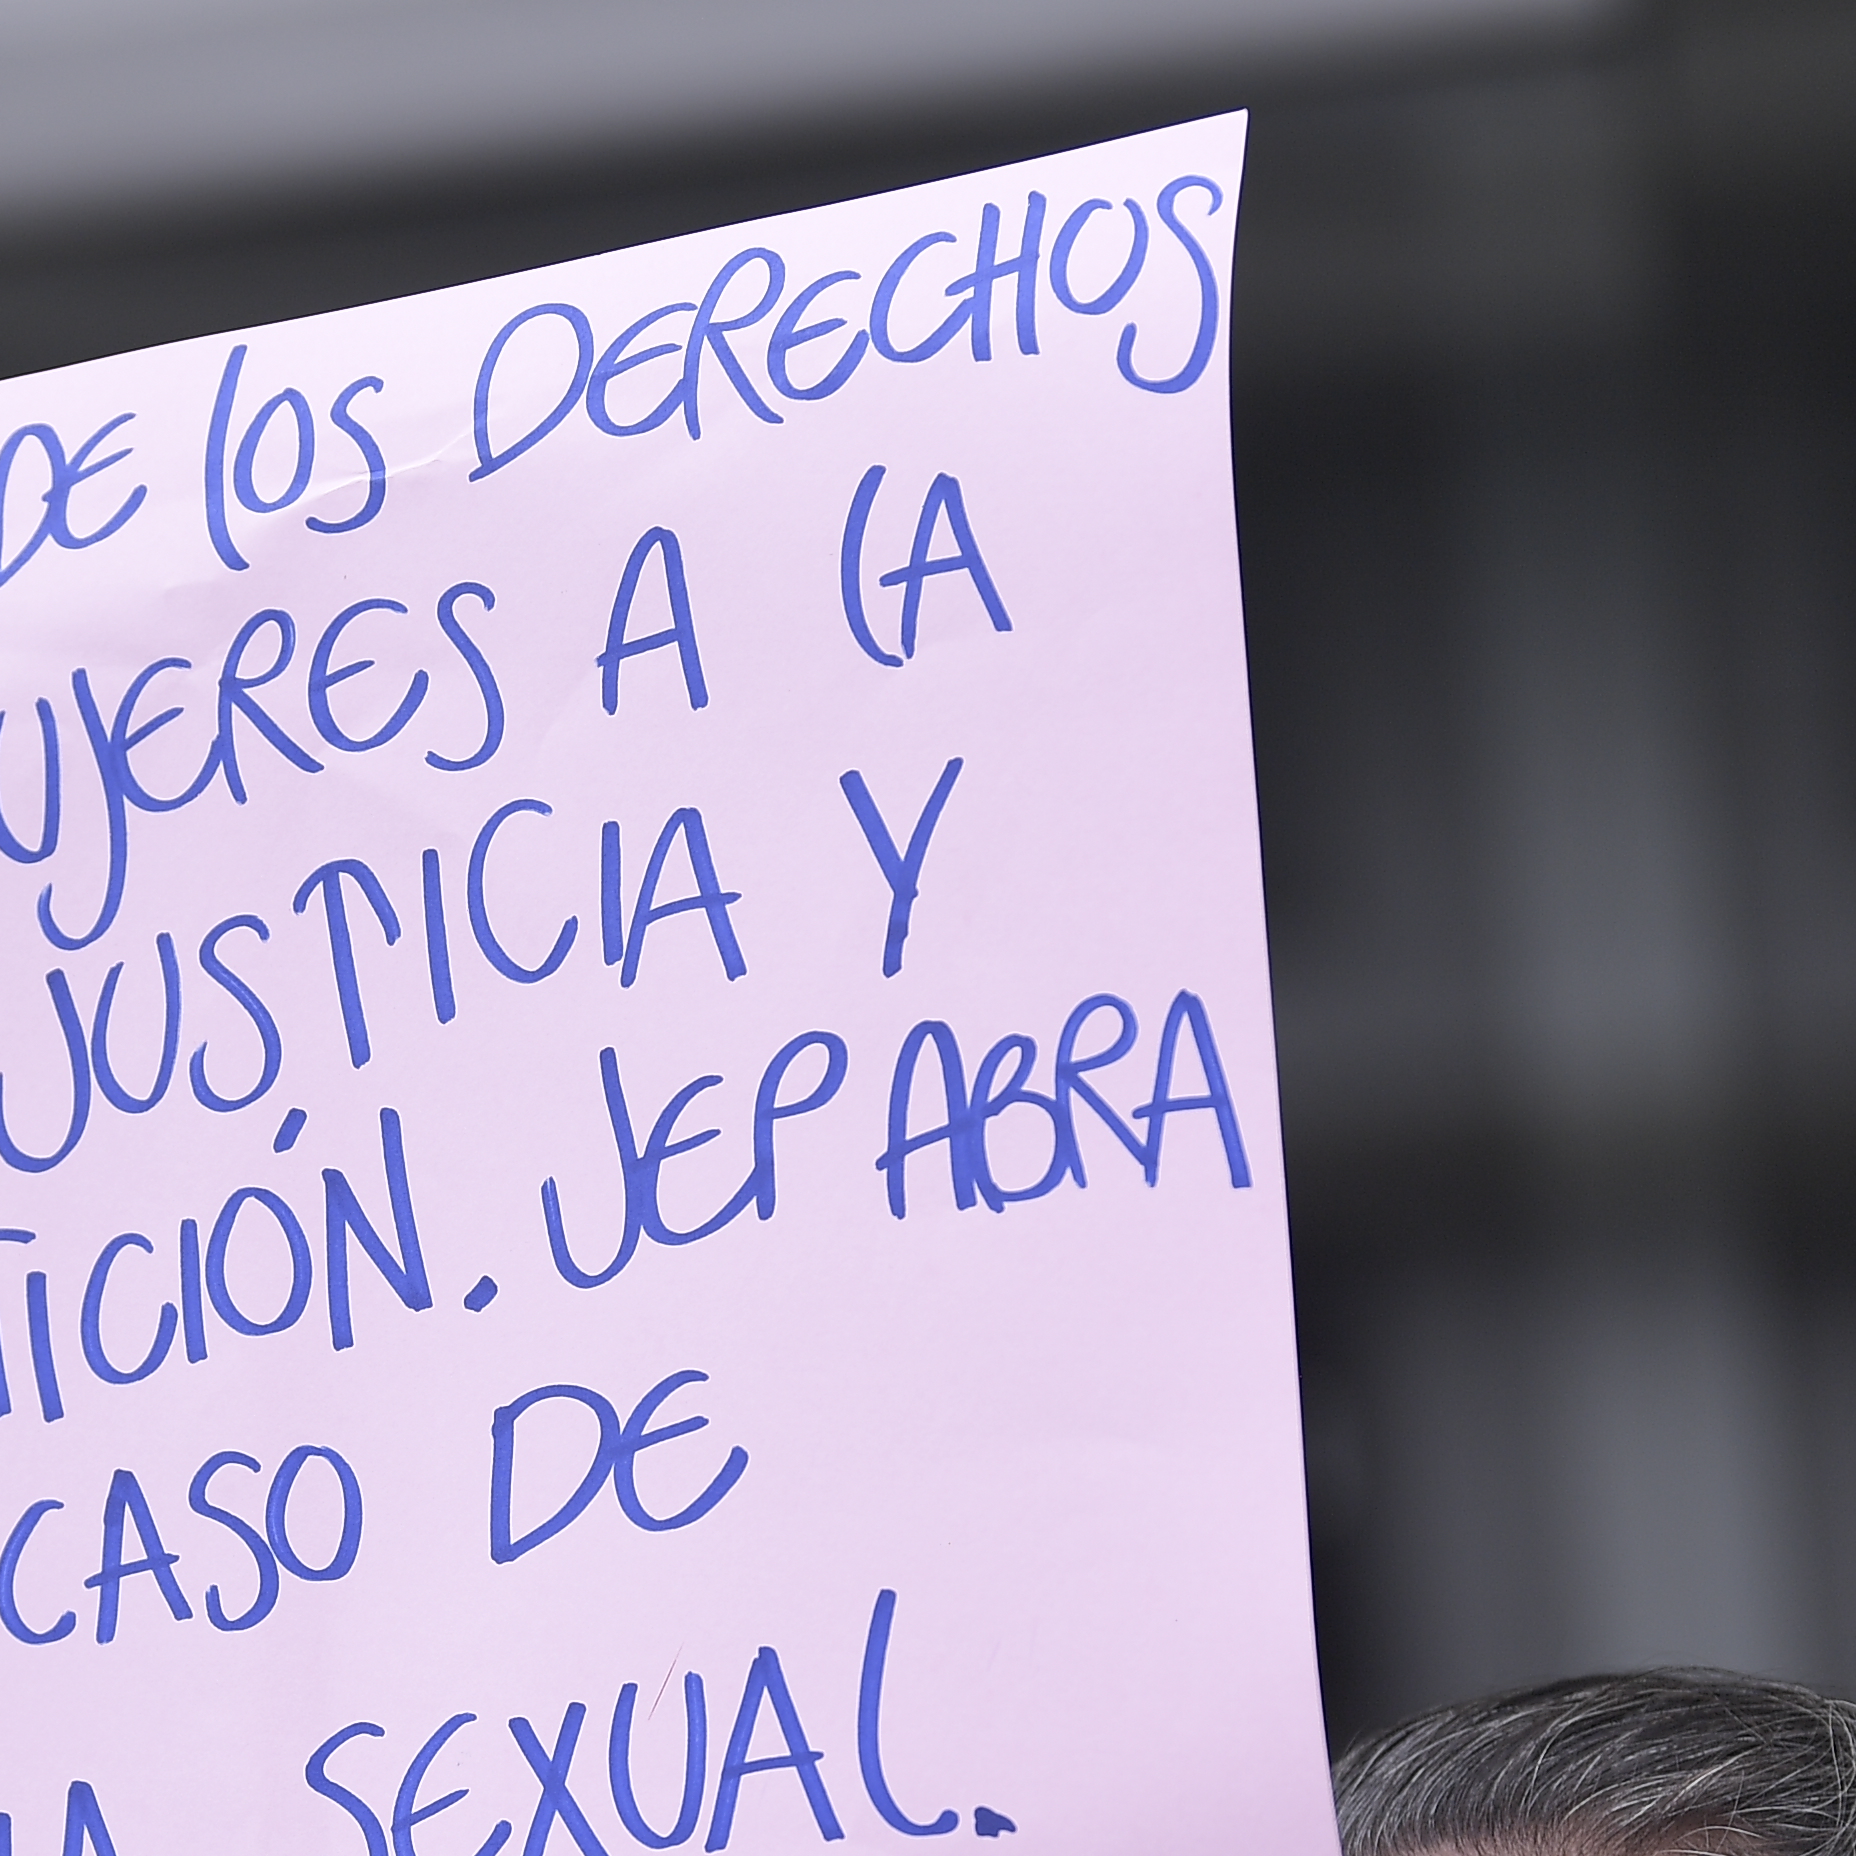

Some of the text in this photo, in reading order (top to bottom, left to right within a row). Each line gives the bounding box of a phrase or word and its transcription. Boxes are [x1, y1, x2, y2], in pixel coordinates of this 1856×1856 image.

[469, 176, 1222, 482] DERECHOS
[597, 527, 708, 715] A
[840, 758, 963, 978] Y
[542, 1031, 848, 1288] JEP
[876, 990, 1251, 1219] ABRA
[491, 1370, 748, 1564] DE
